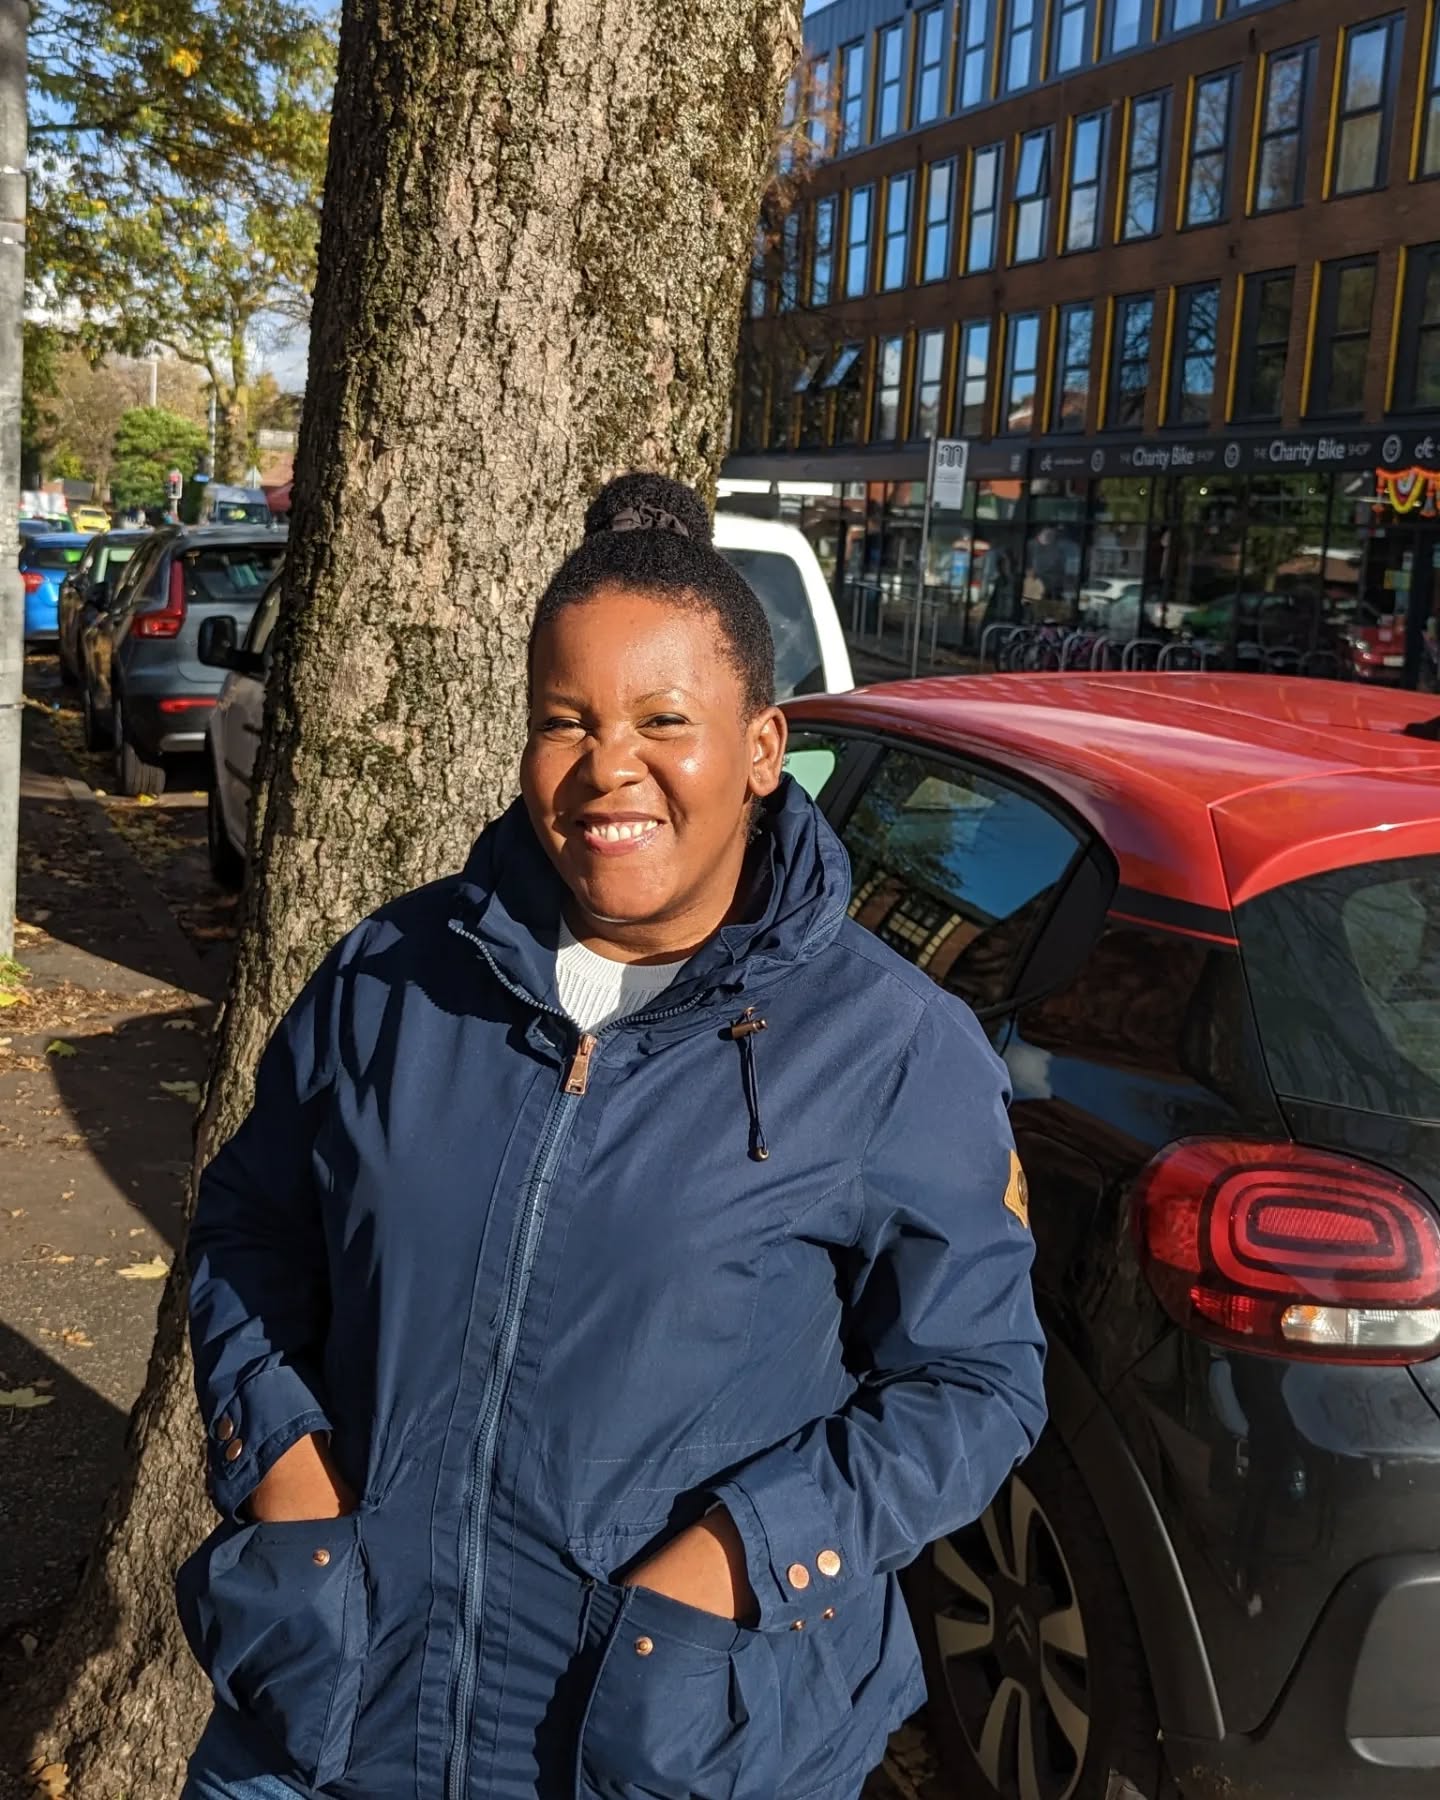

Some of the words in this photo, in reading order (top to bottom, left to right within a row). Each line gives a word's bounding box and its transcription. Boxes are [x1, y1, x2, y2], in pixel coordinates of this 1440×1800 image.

[1132, 445, 1169, 471] Charity
[1171, 444, 1194, 465] Bike
[1269, 439, 1315, 466] Charity
[1317, 437, 1345, 460] Bike
